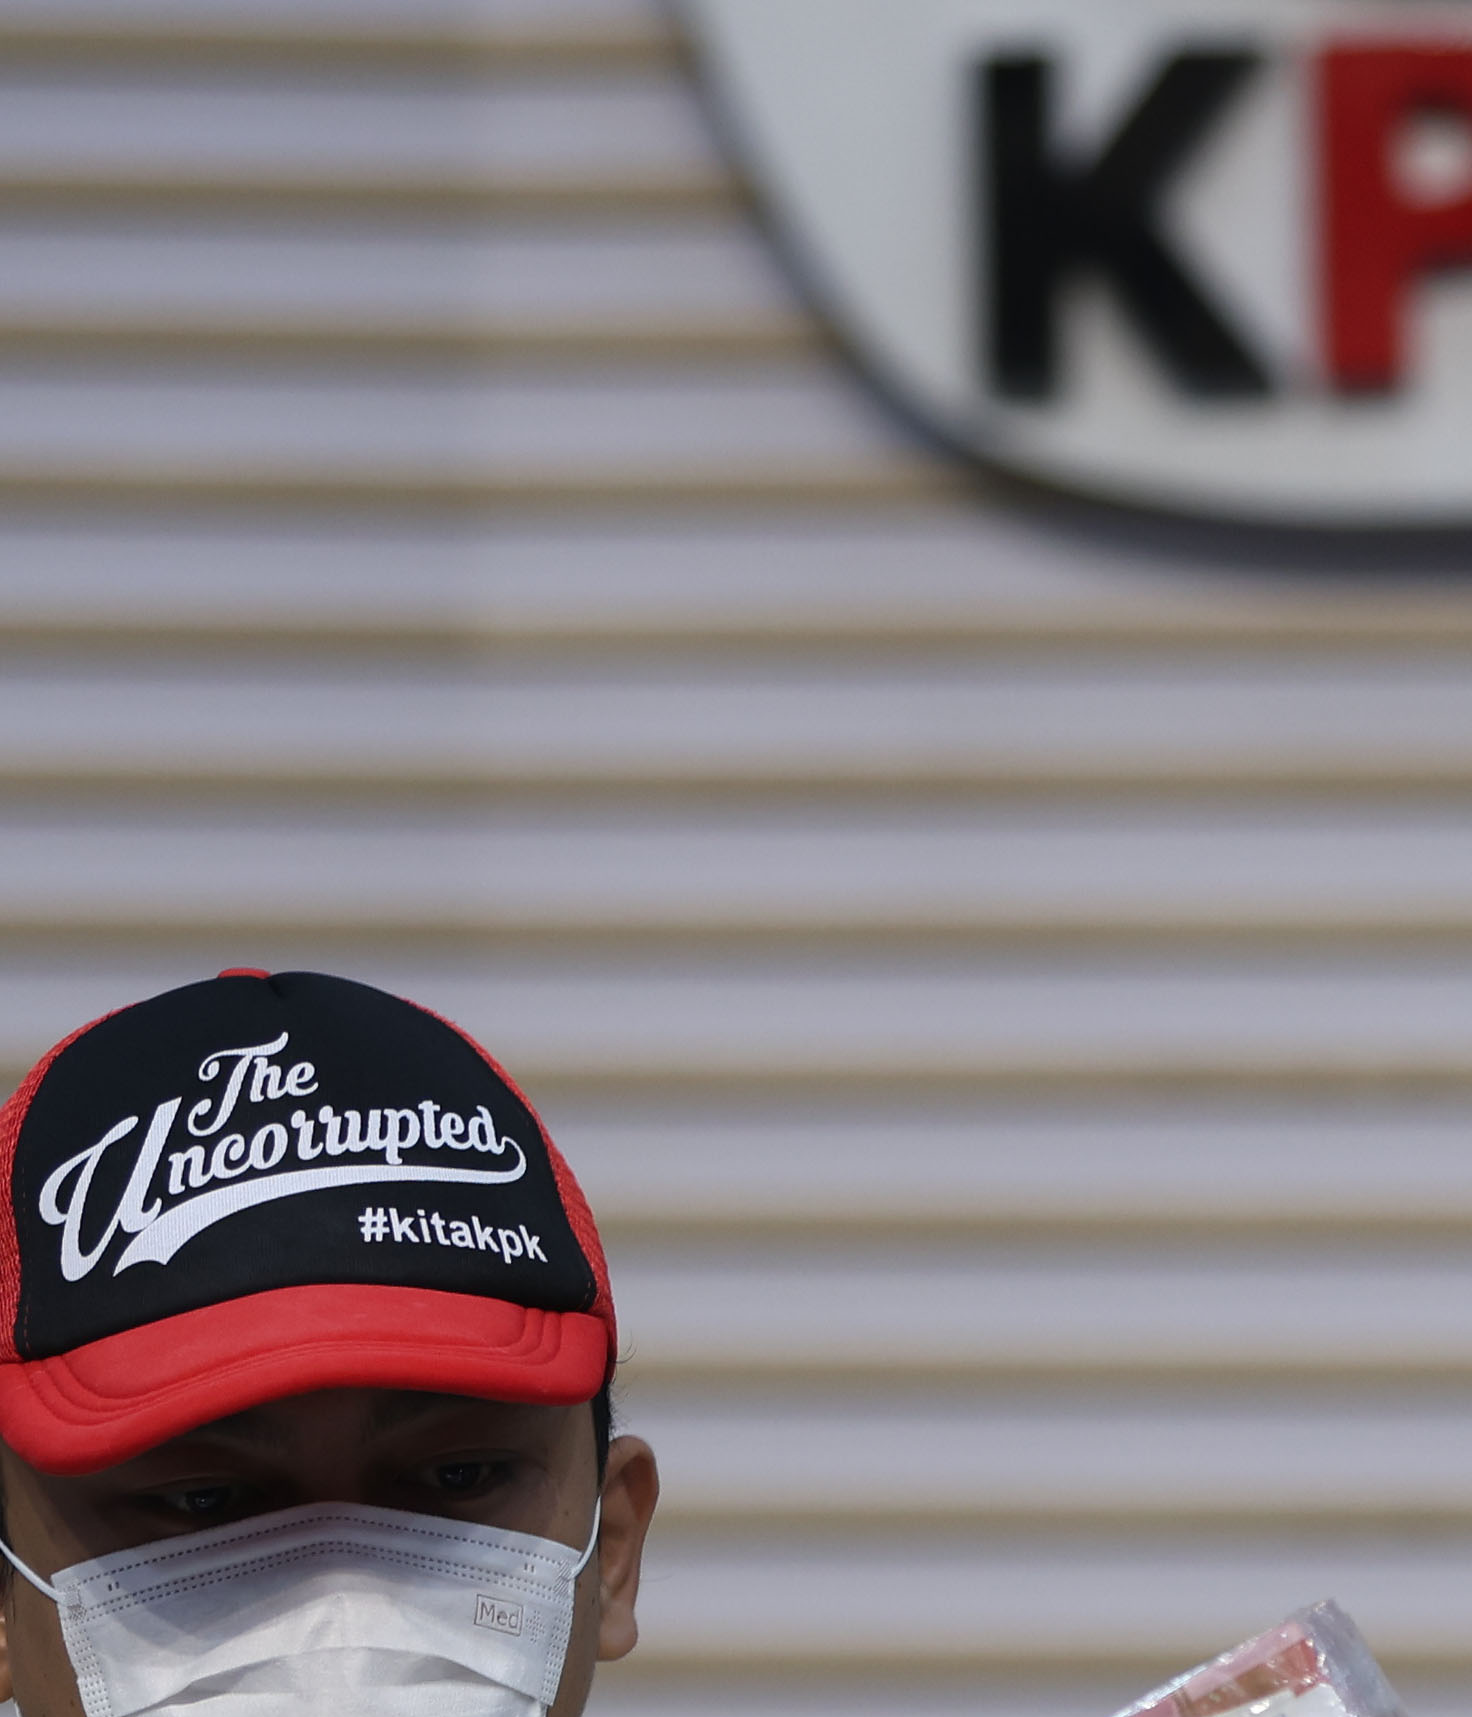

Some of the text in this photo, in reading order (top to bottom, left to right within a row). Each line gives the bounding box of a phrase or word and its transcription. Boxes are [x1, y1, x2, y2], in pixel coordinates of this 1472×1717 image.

[187, 1031, 319, 1137] The
[38, 1096, 526, 1283] Uncorrupted
[357, 1206, 548, 1264] #kitakpk
[479, 1602, 521, 1630] Med
